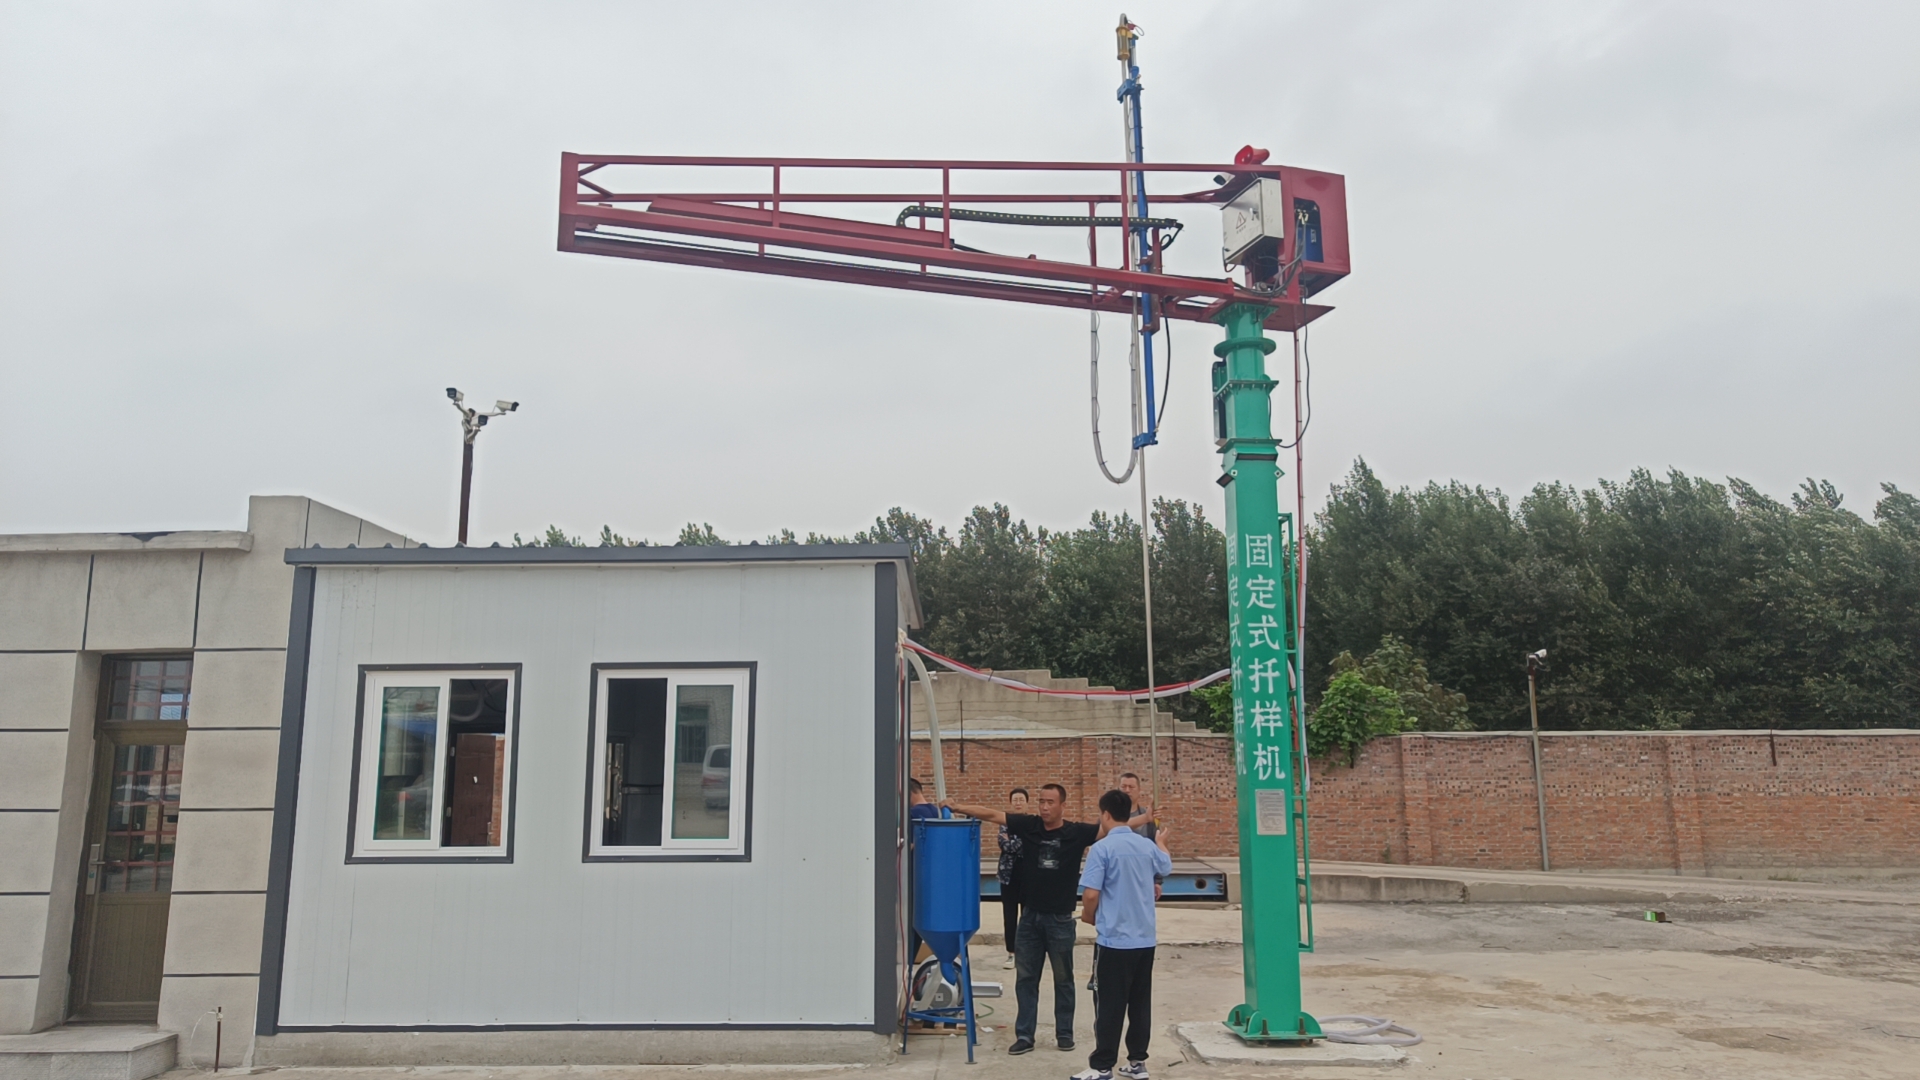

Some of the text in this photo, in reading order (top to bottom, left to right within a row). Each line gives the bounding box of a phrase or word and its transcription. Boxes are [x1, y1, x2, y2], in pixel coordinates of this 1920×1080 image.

[1245, 533, 1286, 781] 固定式扦样机
